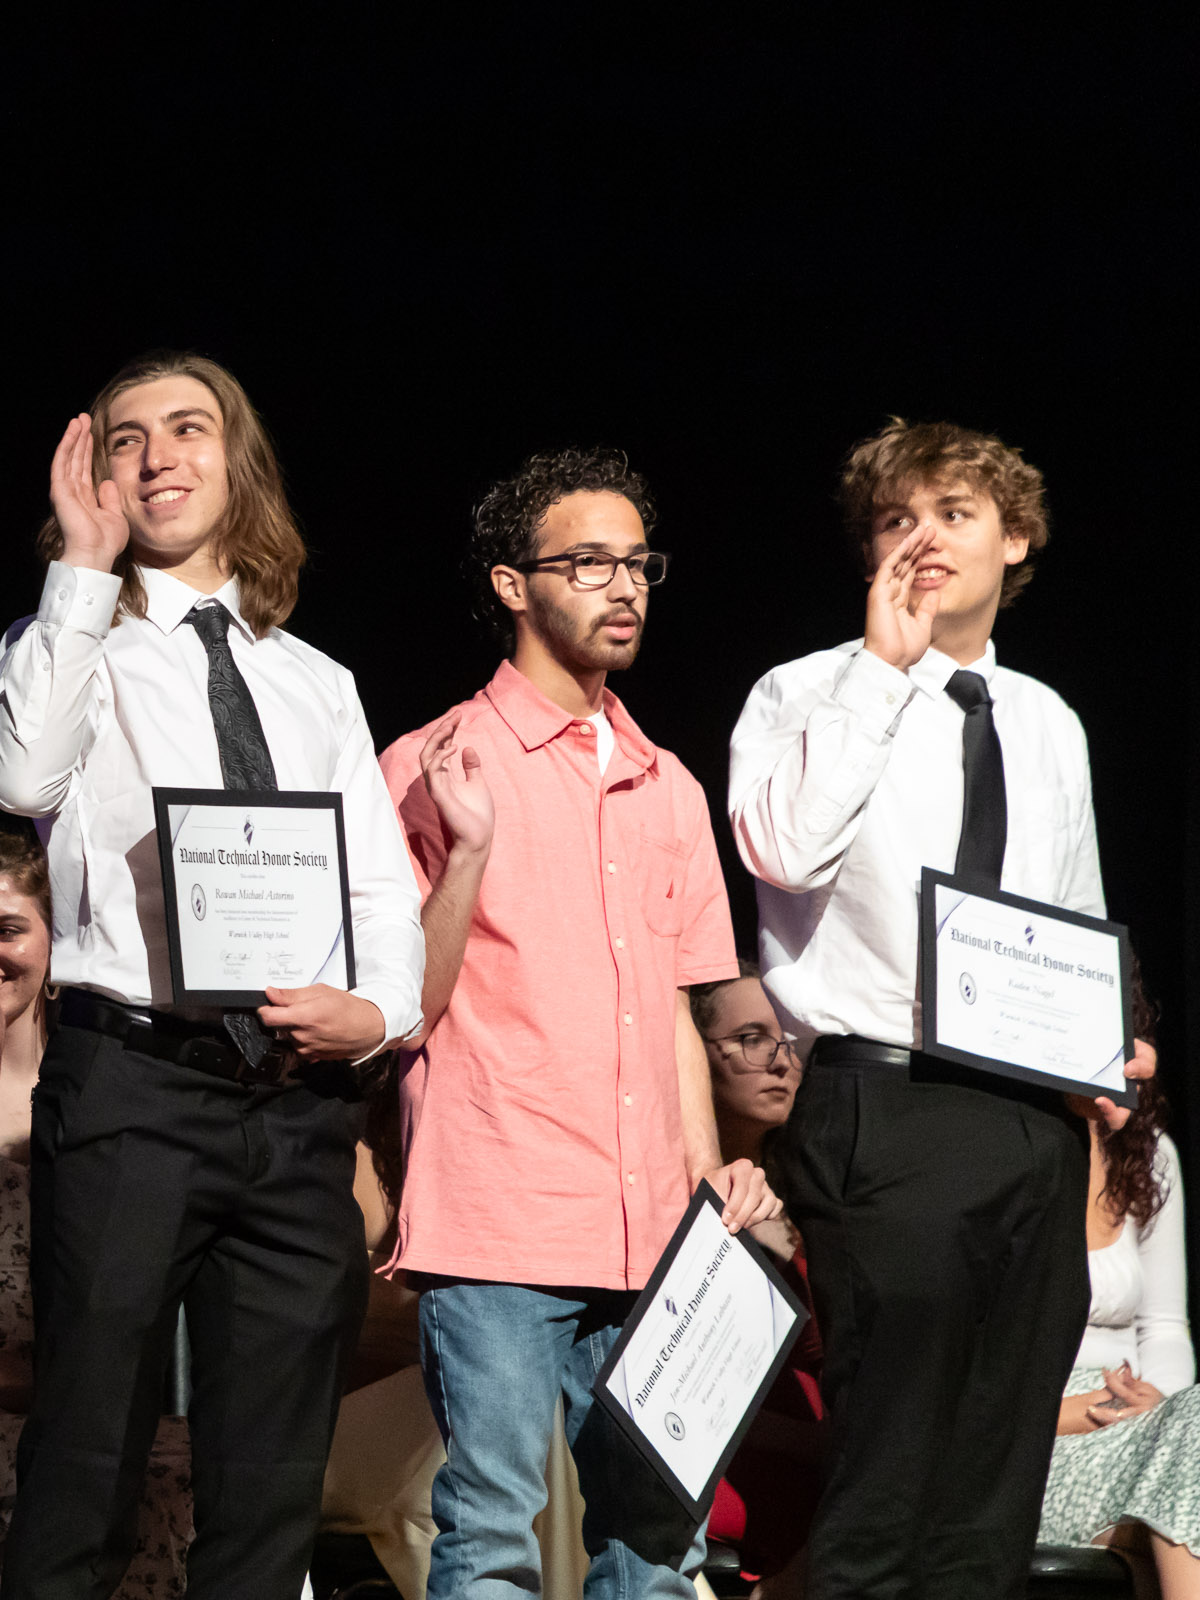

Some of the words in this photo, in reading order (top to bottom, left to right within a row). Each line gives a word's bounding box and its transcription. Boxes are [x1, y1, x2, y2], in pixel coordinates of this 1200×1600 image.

[179, 848, 215, 864] National
[218, 849, 260, 867] Technical
[262, 851, 291, 866] Honor
[293, 851, 328, 871] Society
[215, 888, 237, 899] Rowan
[238, 889, 264, 900] Michael
[951, 927, 991, 951] National
[993, 940, 1040, 966] Technical
[1043, 954, 1075, 974] Honor
[1077, 964, 1114, 988] Society
[635, 1359, 664, 1408] National
[659, 1309, 693, 1363] Technical
[691, 1276, 711, 1314] Honor
[707, 1238, 733, 1280] Society
